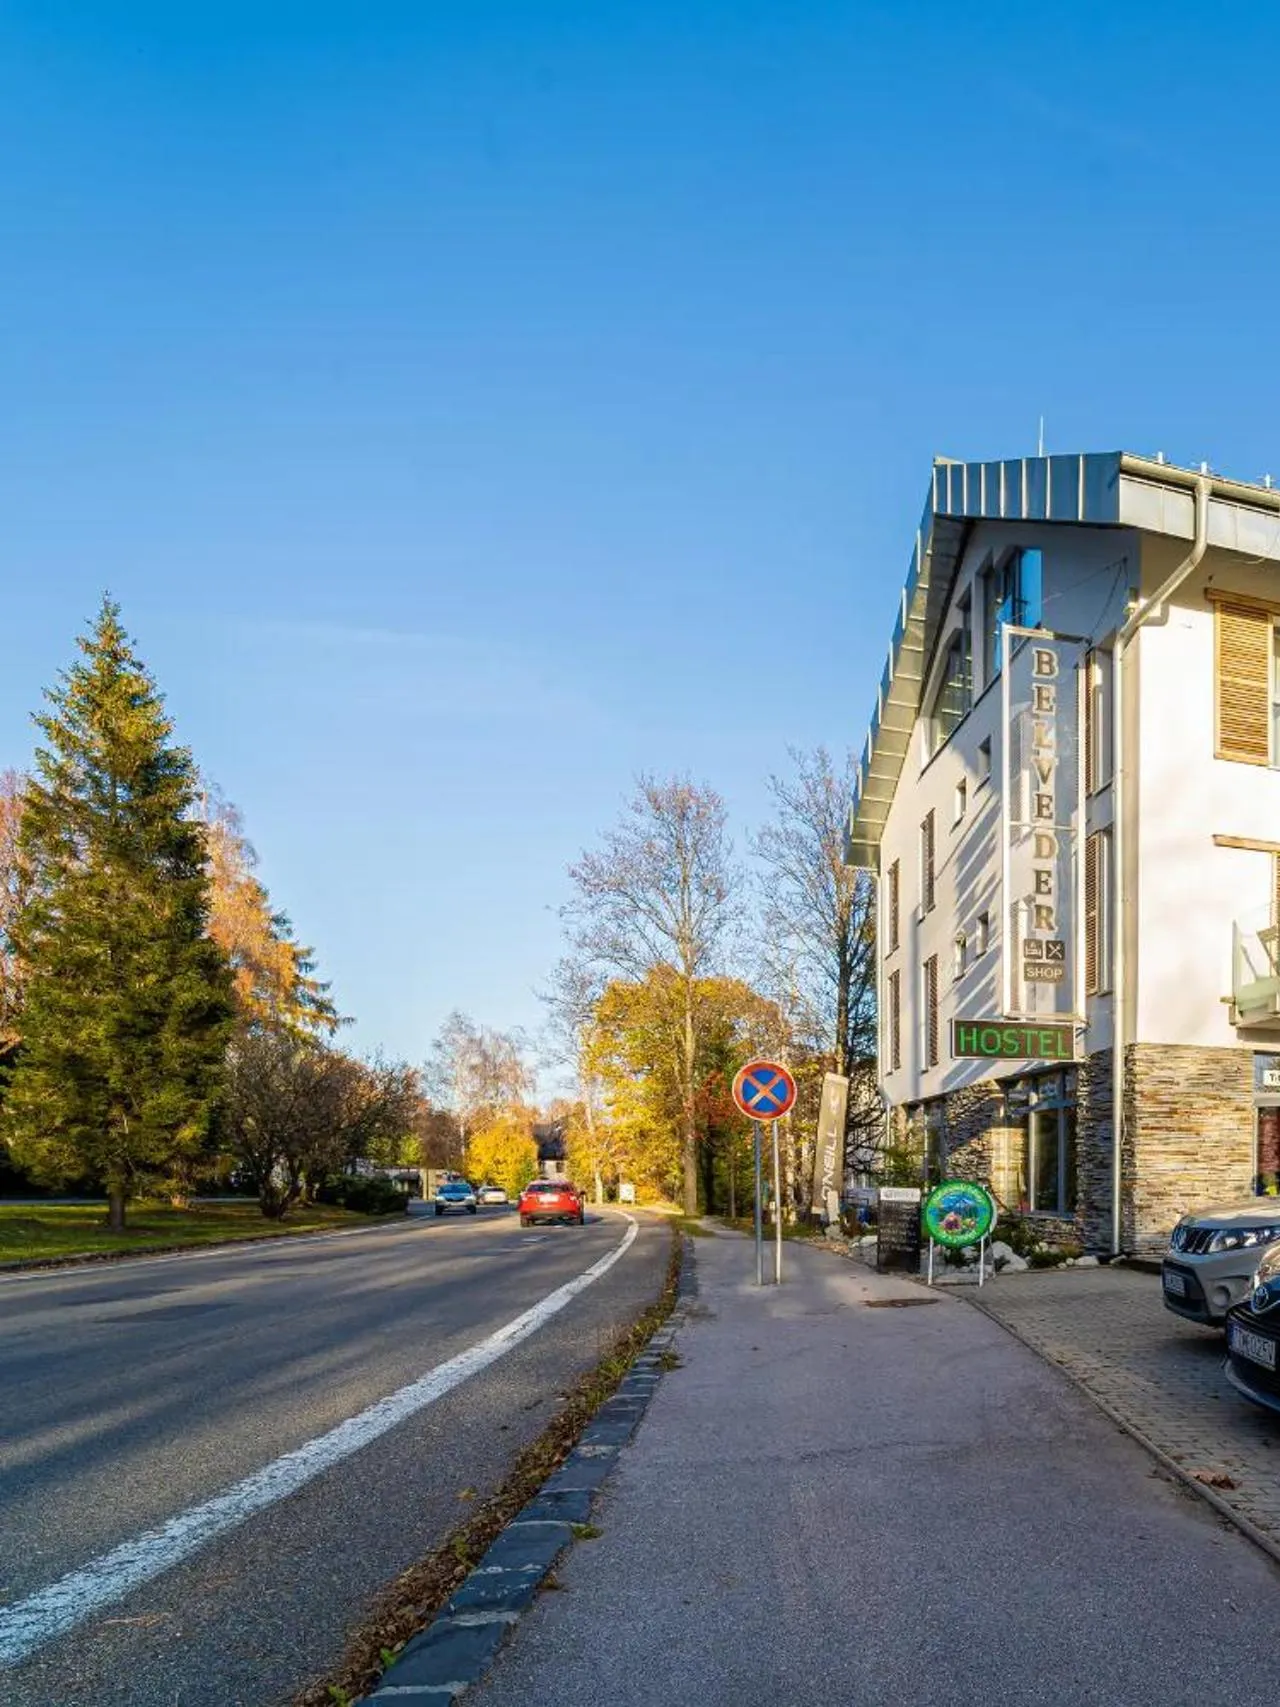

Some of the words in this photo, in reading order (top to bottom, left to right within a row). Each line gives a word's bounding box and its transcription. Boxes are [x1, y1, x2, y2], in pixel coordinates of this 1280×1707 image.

[1032, 648, 1059, 931] BELVEDER
[1026, 967, 1063, 979] SHOP
[959, 1026, 1071, 1057] HOSTEL
